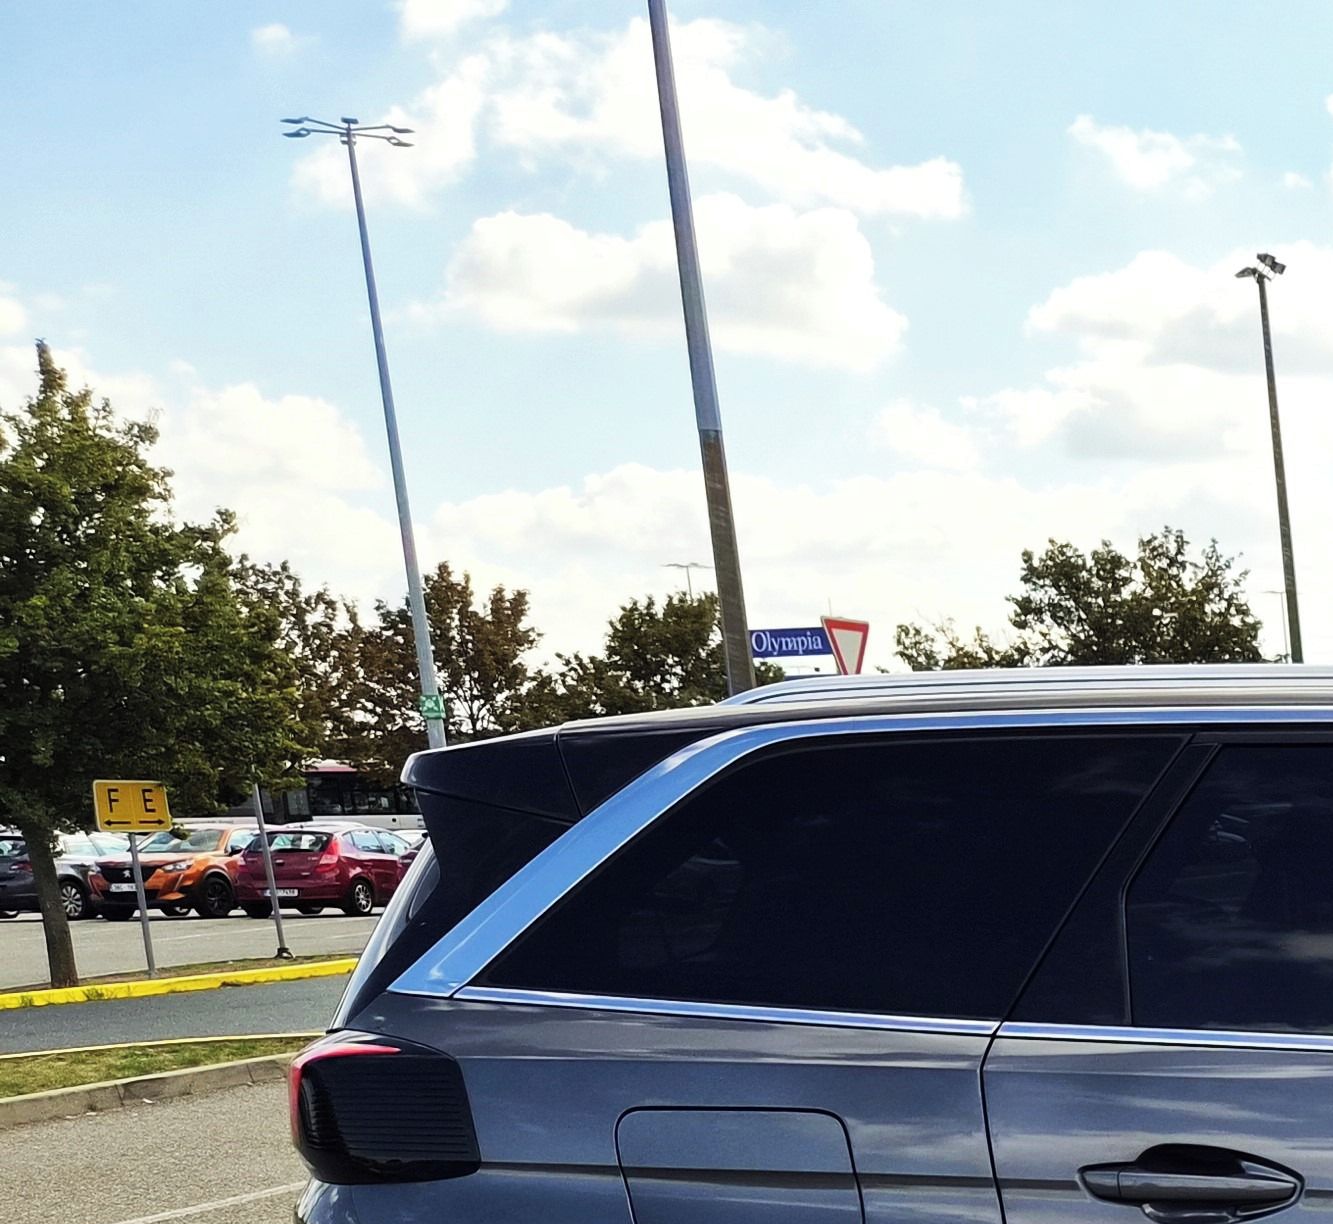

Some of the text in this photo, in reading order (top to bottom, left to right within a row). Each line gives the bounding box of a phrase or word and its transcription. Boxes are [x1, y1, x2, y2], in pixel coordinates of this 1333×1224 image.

[751, 630, 823, 656] Olympia
[107, 788, 156, 813] F E
